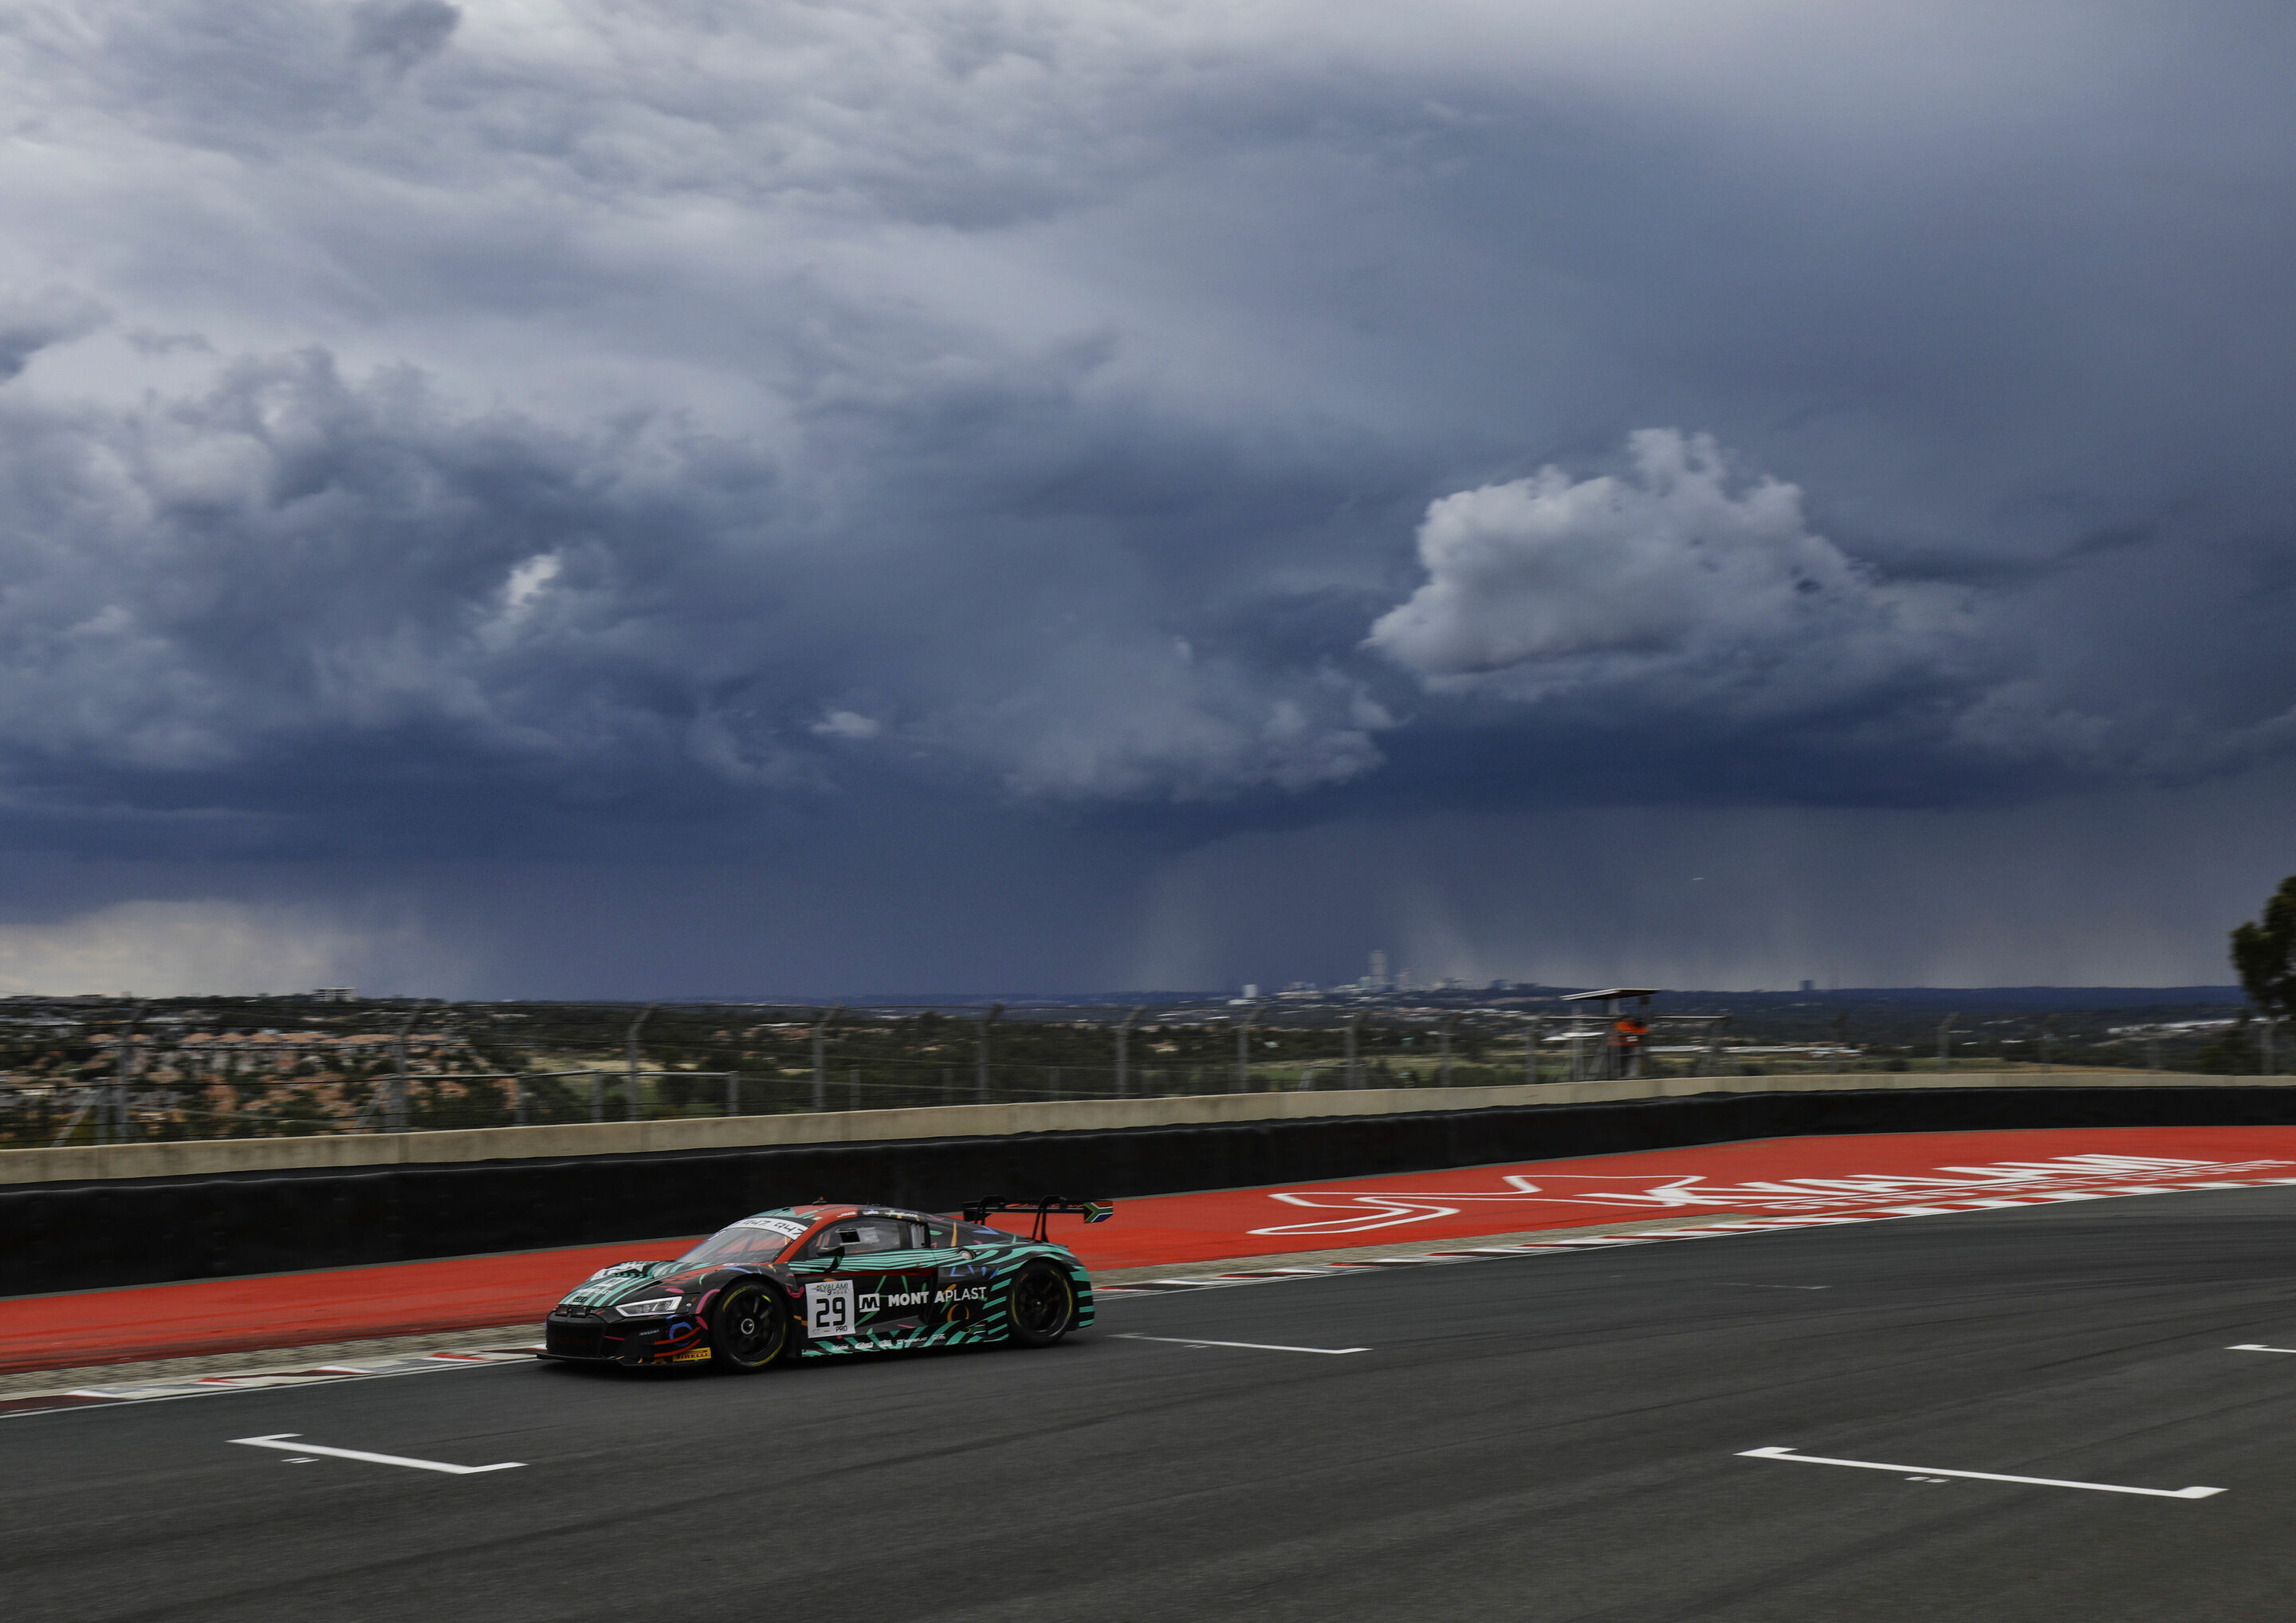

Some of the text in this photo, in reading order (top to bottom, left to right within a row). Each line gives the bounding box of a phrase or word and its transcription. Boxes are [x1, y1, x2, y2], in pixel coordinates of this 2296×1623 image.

[1572, 1153, 2225, 1206] KYALAMI
[1762, 1191, 1979, 1210] GRAND
[1975, 1181, 2117, 1192] PRIX
[816, 1296, 846, 1328] 29
[675, 1350, 708, 1360] PIRELLI
